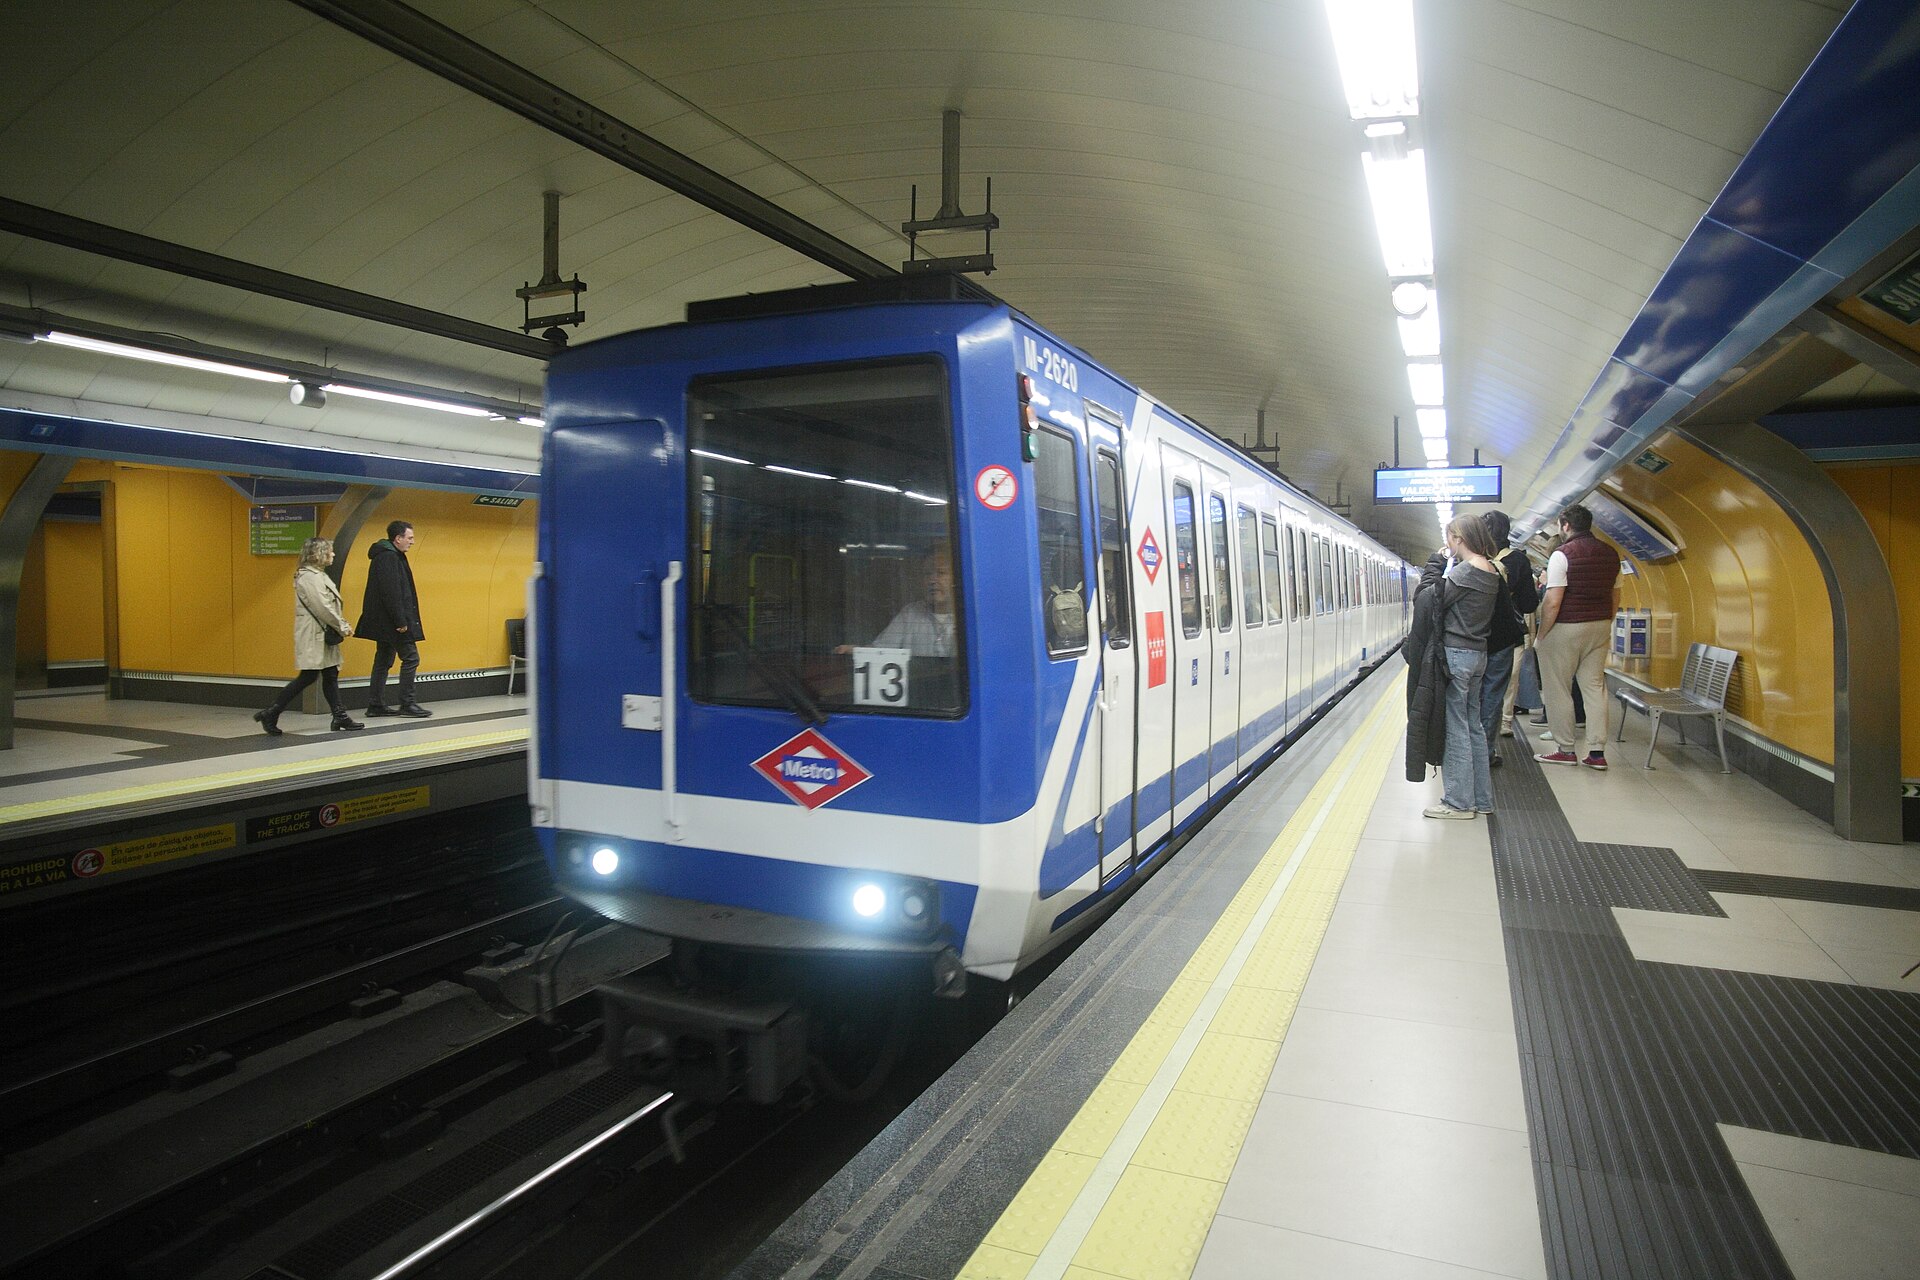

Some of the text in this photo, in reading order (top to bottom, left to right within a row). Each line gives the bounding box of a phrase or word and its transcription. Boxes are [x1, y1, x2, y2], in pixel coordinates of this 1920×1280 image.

[1023, 335, 1078, 393] M-2620
[489, 497, 519, 506] SALIDA
[854, 661, 904, 703] 13
[784, 759, 836, 781] Metro
[268, 811, 310, 826] KEEP OFF
[257, 821, 311, 839] THE TRACKS
[111, 845, 122, 857] En
[125, 843, 144, 855] caso
[146, 841, 157, 851] de
[182, 834, 192, 844] de
[153, 844, 188, 858] personal
[189, 841, 199, 850] de
[13, 879, 23, 889] A
[26, 875, 43, 886] LA
